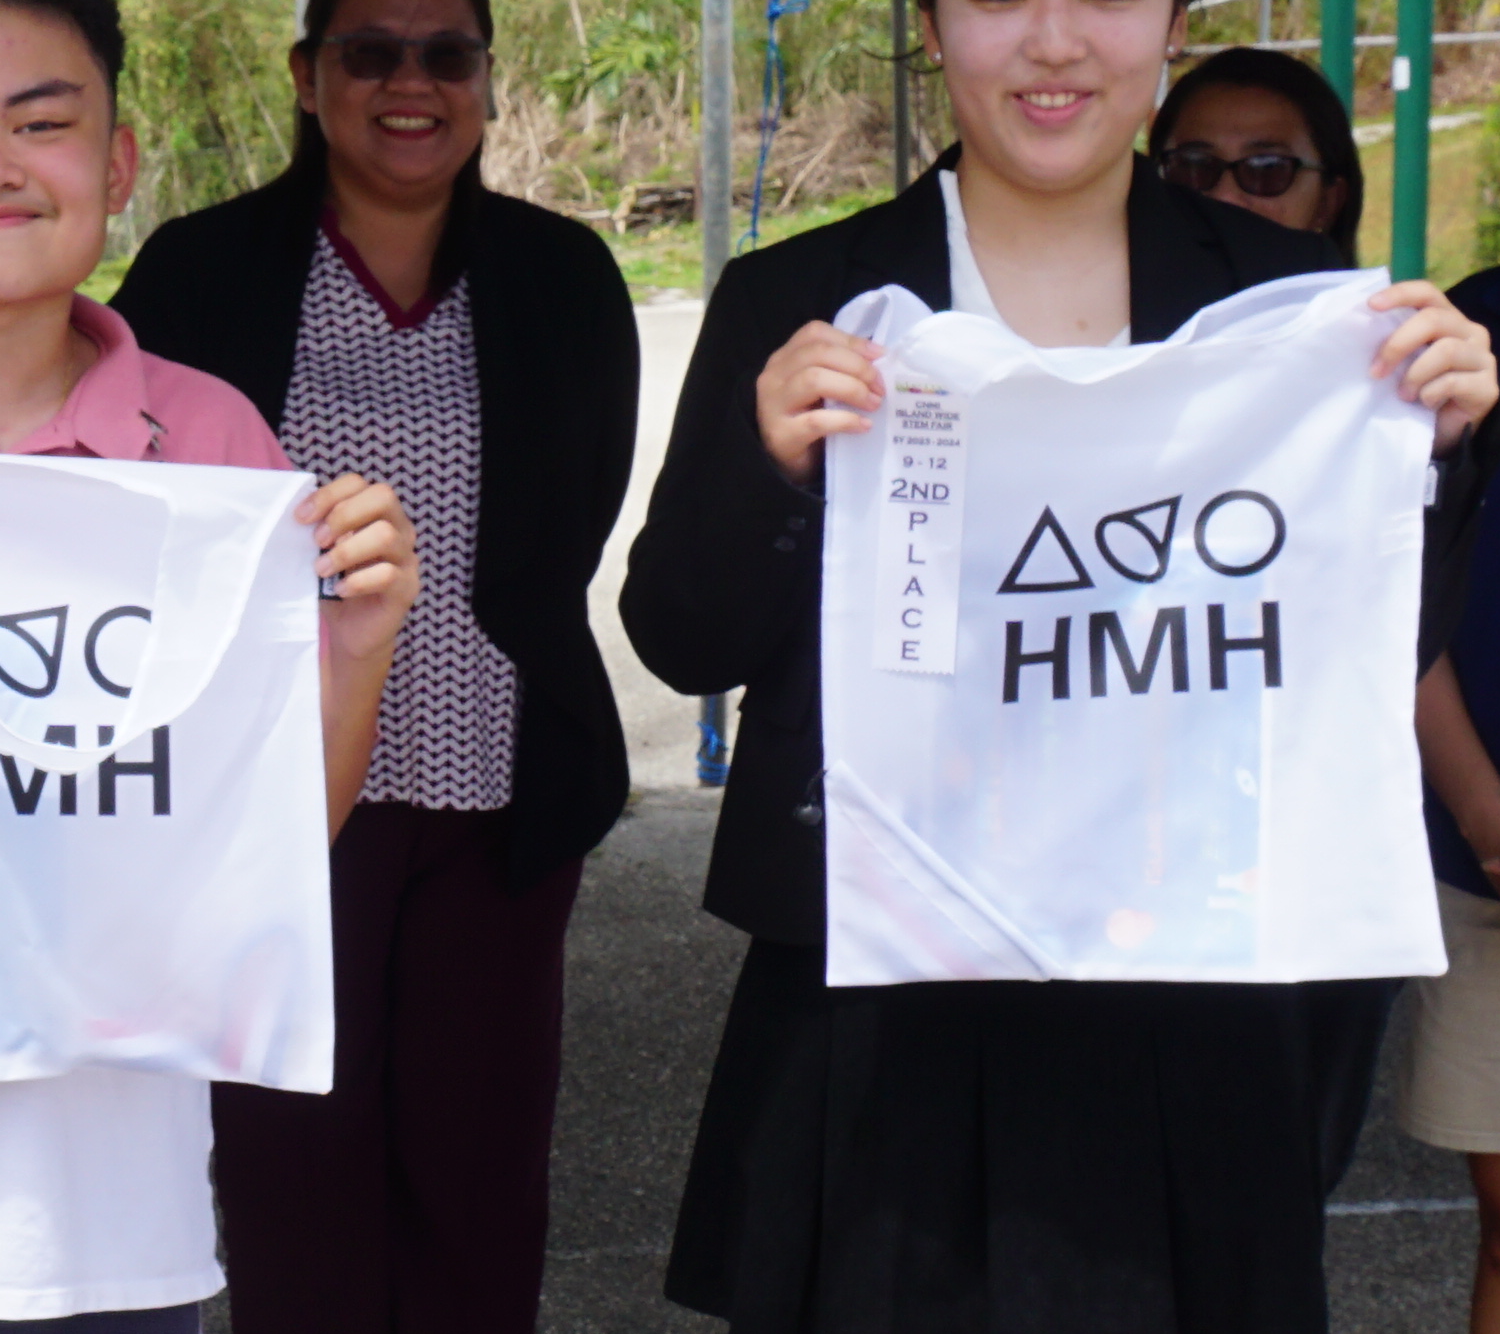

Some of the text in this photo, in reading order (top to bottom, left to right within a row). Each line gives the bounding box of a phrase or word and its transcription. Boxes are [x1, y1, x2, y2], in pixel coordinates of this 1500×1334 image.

[903, 456, 914, 468] 9
[929, 457, 947, 469] 12
[890, 478, 950, 501] 2ND
[1003, 600, 1283, 704] HMH
